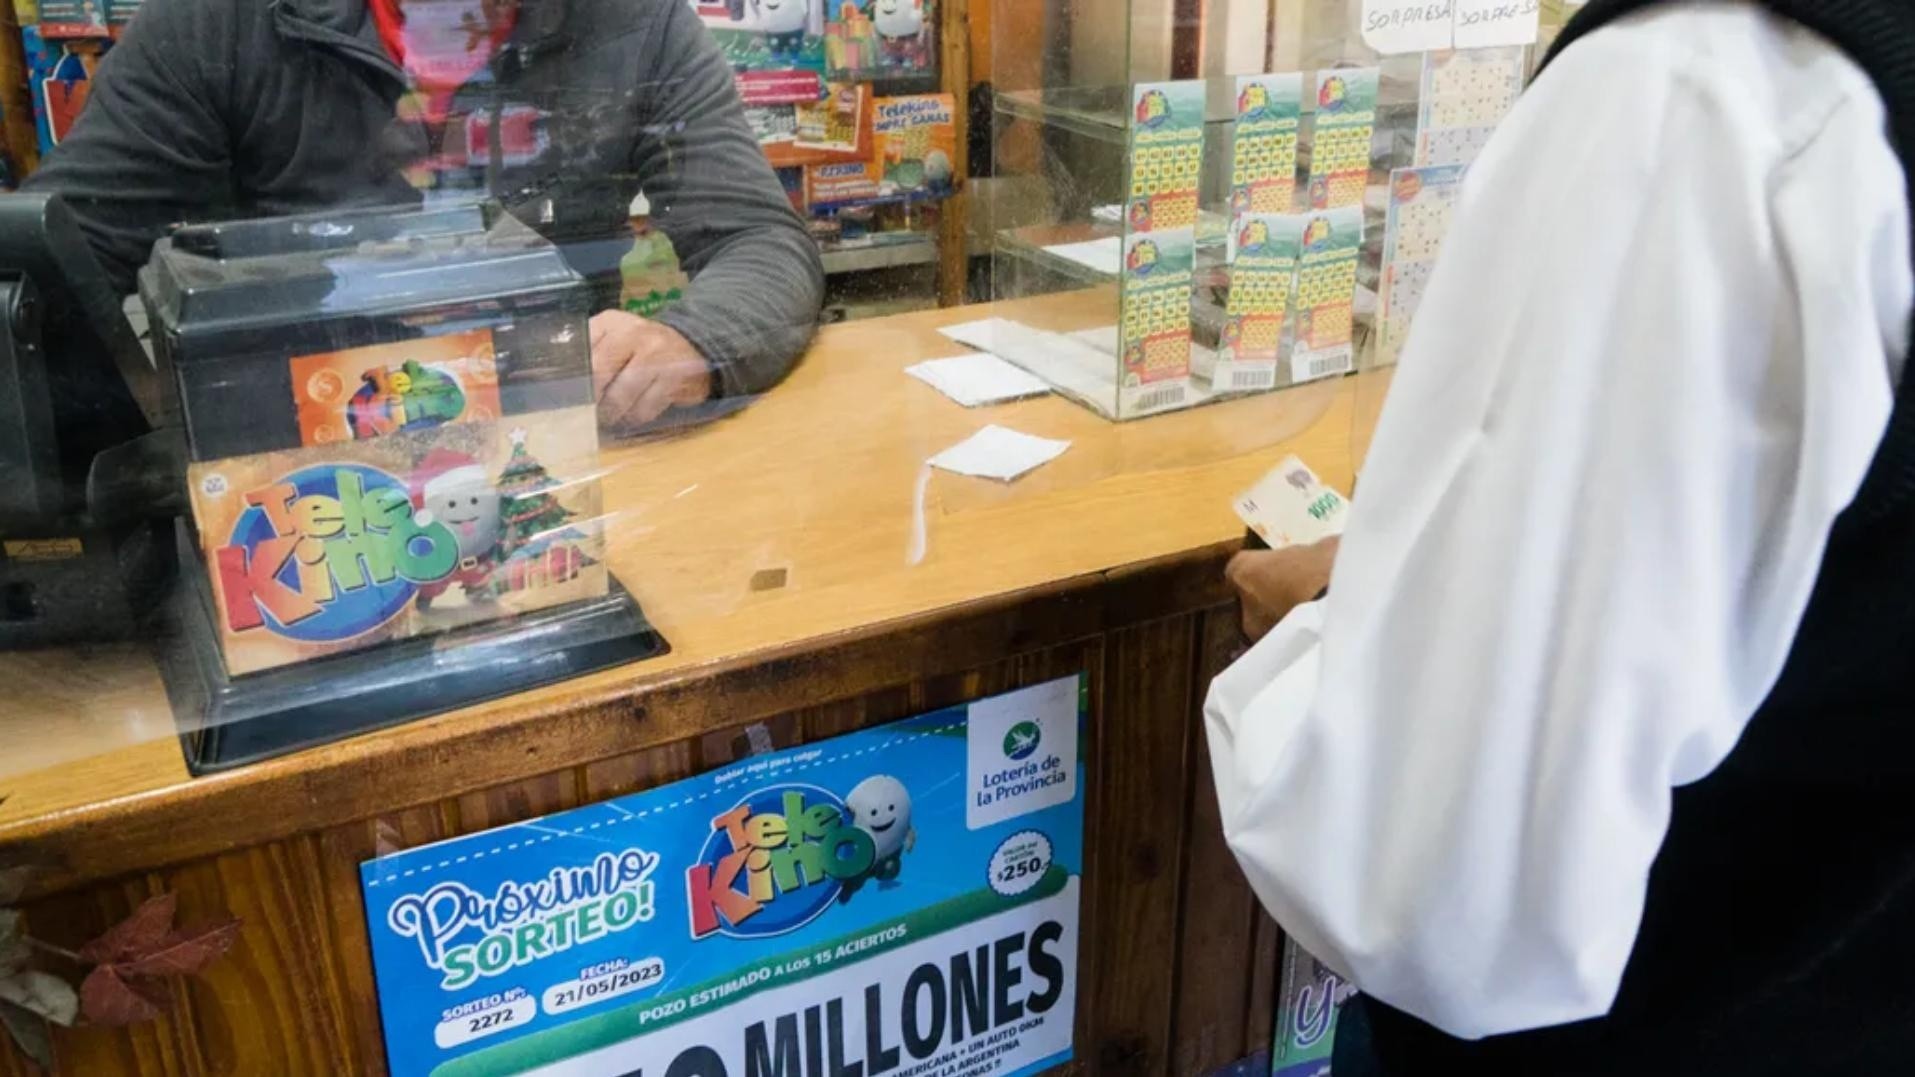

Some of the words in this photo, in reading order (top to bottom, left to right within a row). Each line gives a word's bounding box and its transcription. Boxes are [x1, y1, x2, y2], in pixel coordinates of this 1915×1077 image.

[245, 469, 414, 537] Tele
[217, 521, 459, 631] Kino
[977, 790, 992, 807] la
[996, 770, 1066, 801] Provincia
[983, 761, 1038, 788] Lotería
[1041, 755, 1060, 772] de
[713, 791, 842, 852] Tele
[688, 826, 876, 937] Kino
[393, 851, 655, 965] Próximo
[443, 884, 651, 986] SORTEO!
[554, 964, 662, 1007] 21/05/2023
[580, 957, 629, 980] FECHA:
[639, 998, 686, 1025] POZO
[689, 966, 770, 1007] ESTIMADO
[774, 965, 785, 976] A
[786, 958, 811, 973] LOS
[814, 951, 832, 966] 15
[835, 923, 907, 960] ACIERTOS
[442, 994, 502, 1022] SORTEO
[469, 1009, 514, 1033] 2272
[745, 920, 1064, 1077] MILLONES
[957, 1039, 1020, 1071] ARGENTINA
[968, 1040, 984, 1053] UN
[987, 1027, 1017, 1046] AUTO
